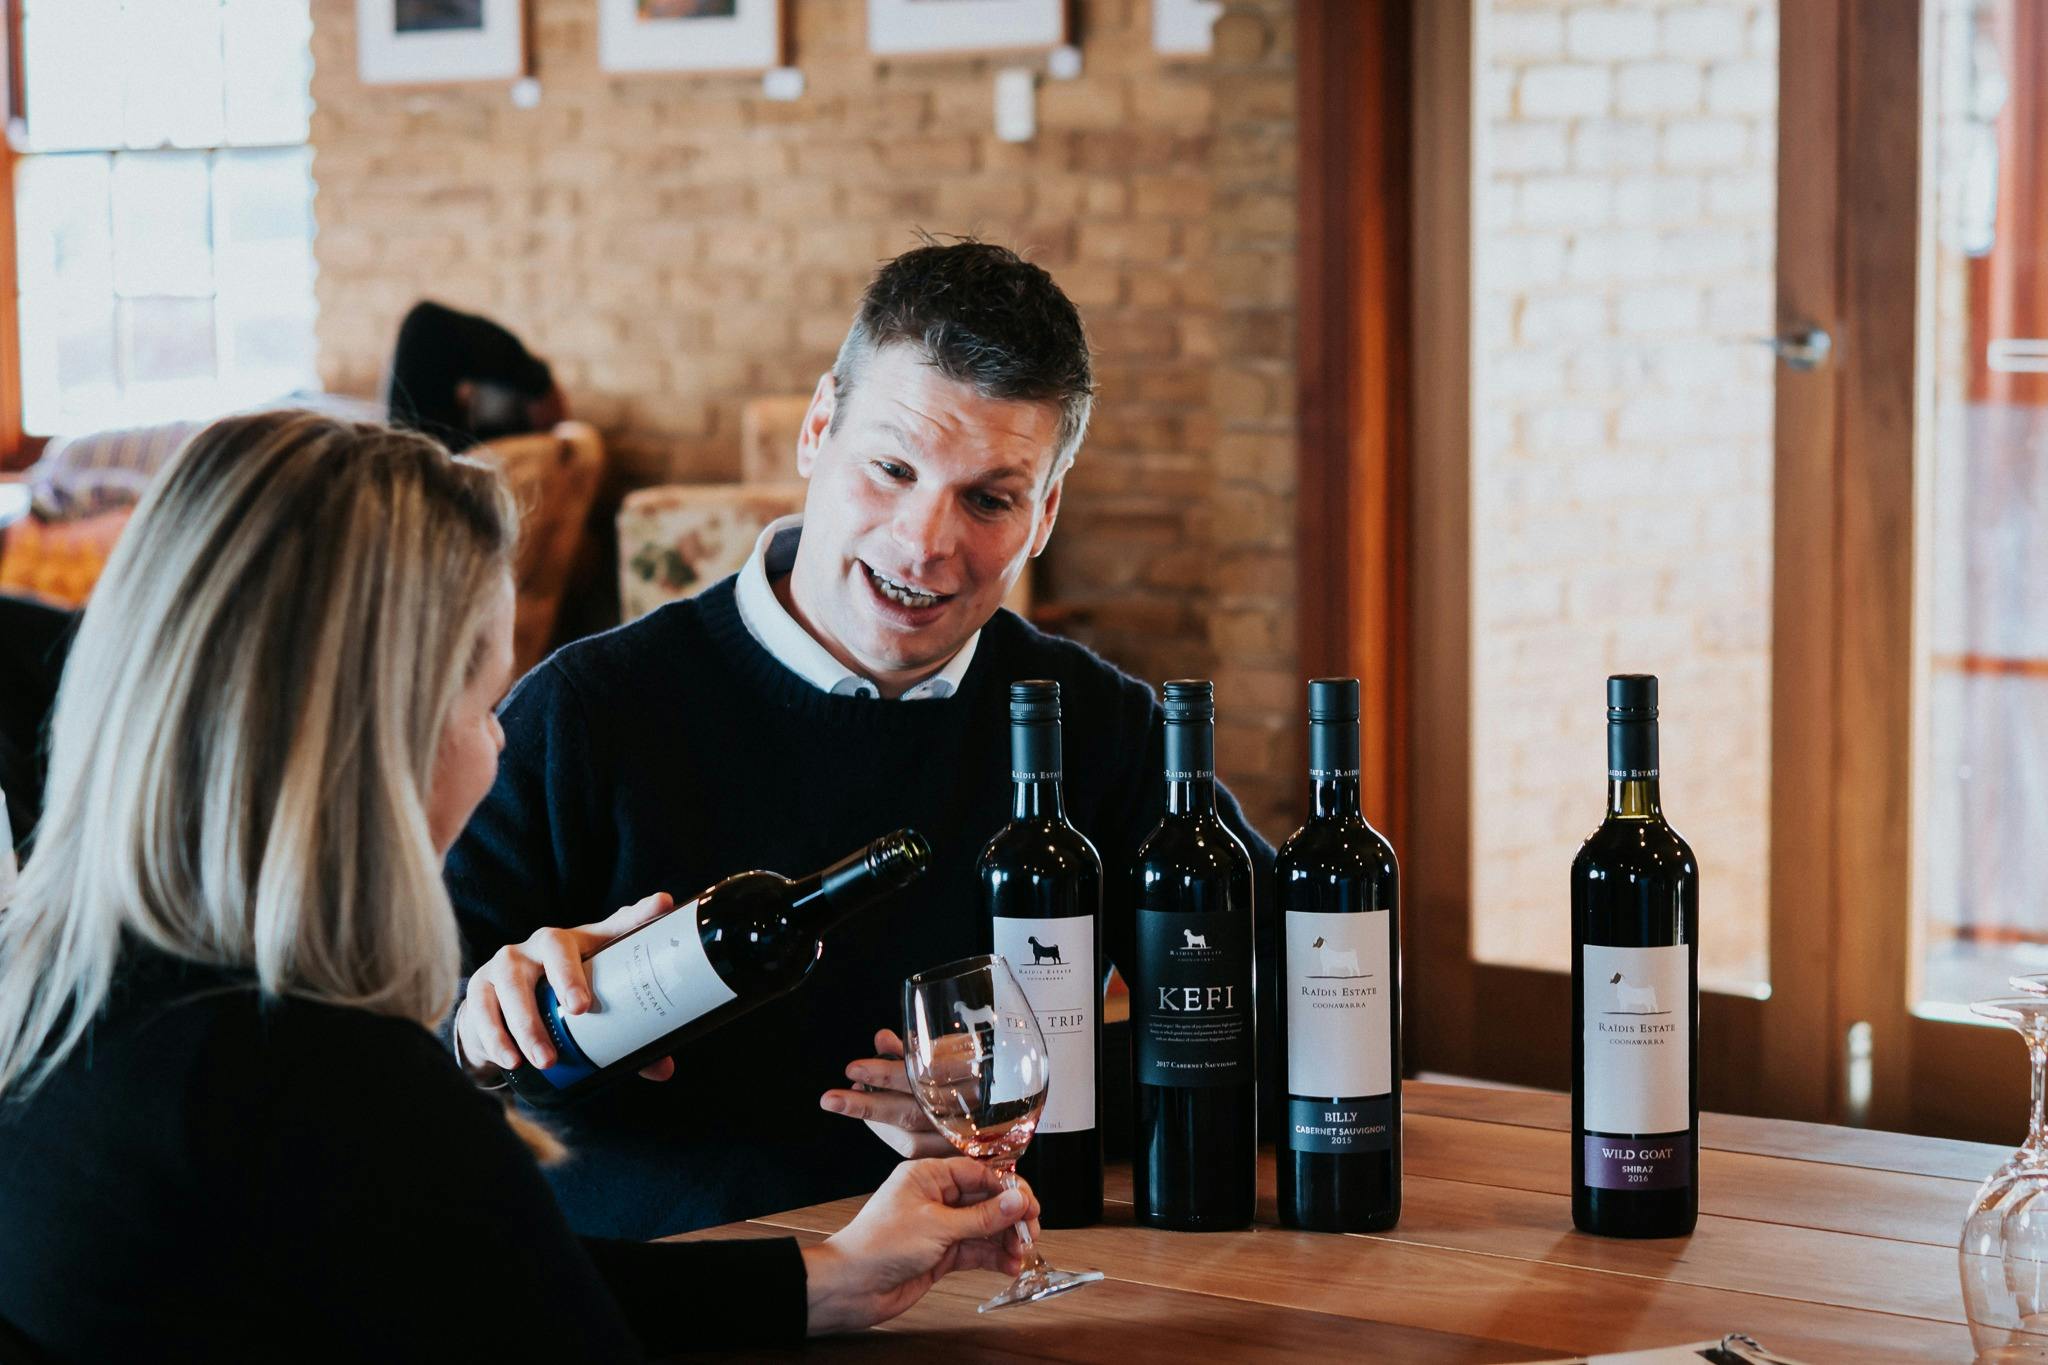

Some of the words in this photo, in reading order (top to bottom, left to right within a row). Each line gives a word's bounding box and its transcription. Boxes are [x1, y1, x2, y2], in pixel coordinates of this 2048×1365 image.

[1342, 986, 1377, 997] ESTATE
[1158, 985, 1234, 1012] KEFI
[1047, 1014, 1084, 1028] TRIP
[1640, 1023, 1676, 1033] ESTATE
[1170, 1061, 1203, 1069] CABERNET
[1325, 1112, 1358, 1123] BILLY
[1295, 1125, 1337, 1136] CABERNET
[1339, 1125, 1386, 1136] SAUVIGNON
[1331, 1136, 1352, 1145] 2015
[1601, 1147, 1636, 1160] WILD
[1639, 1147, 1674, 1160] GOAT
[1621, 1165, 1654, 1174] SHIRAZ
[1628, 1174, 1649, 1183] 2016
